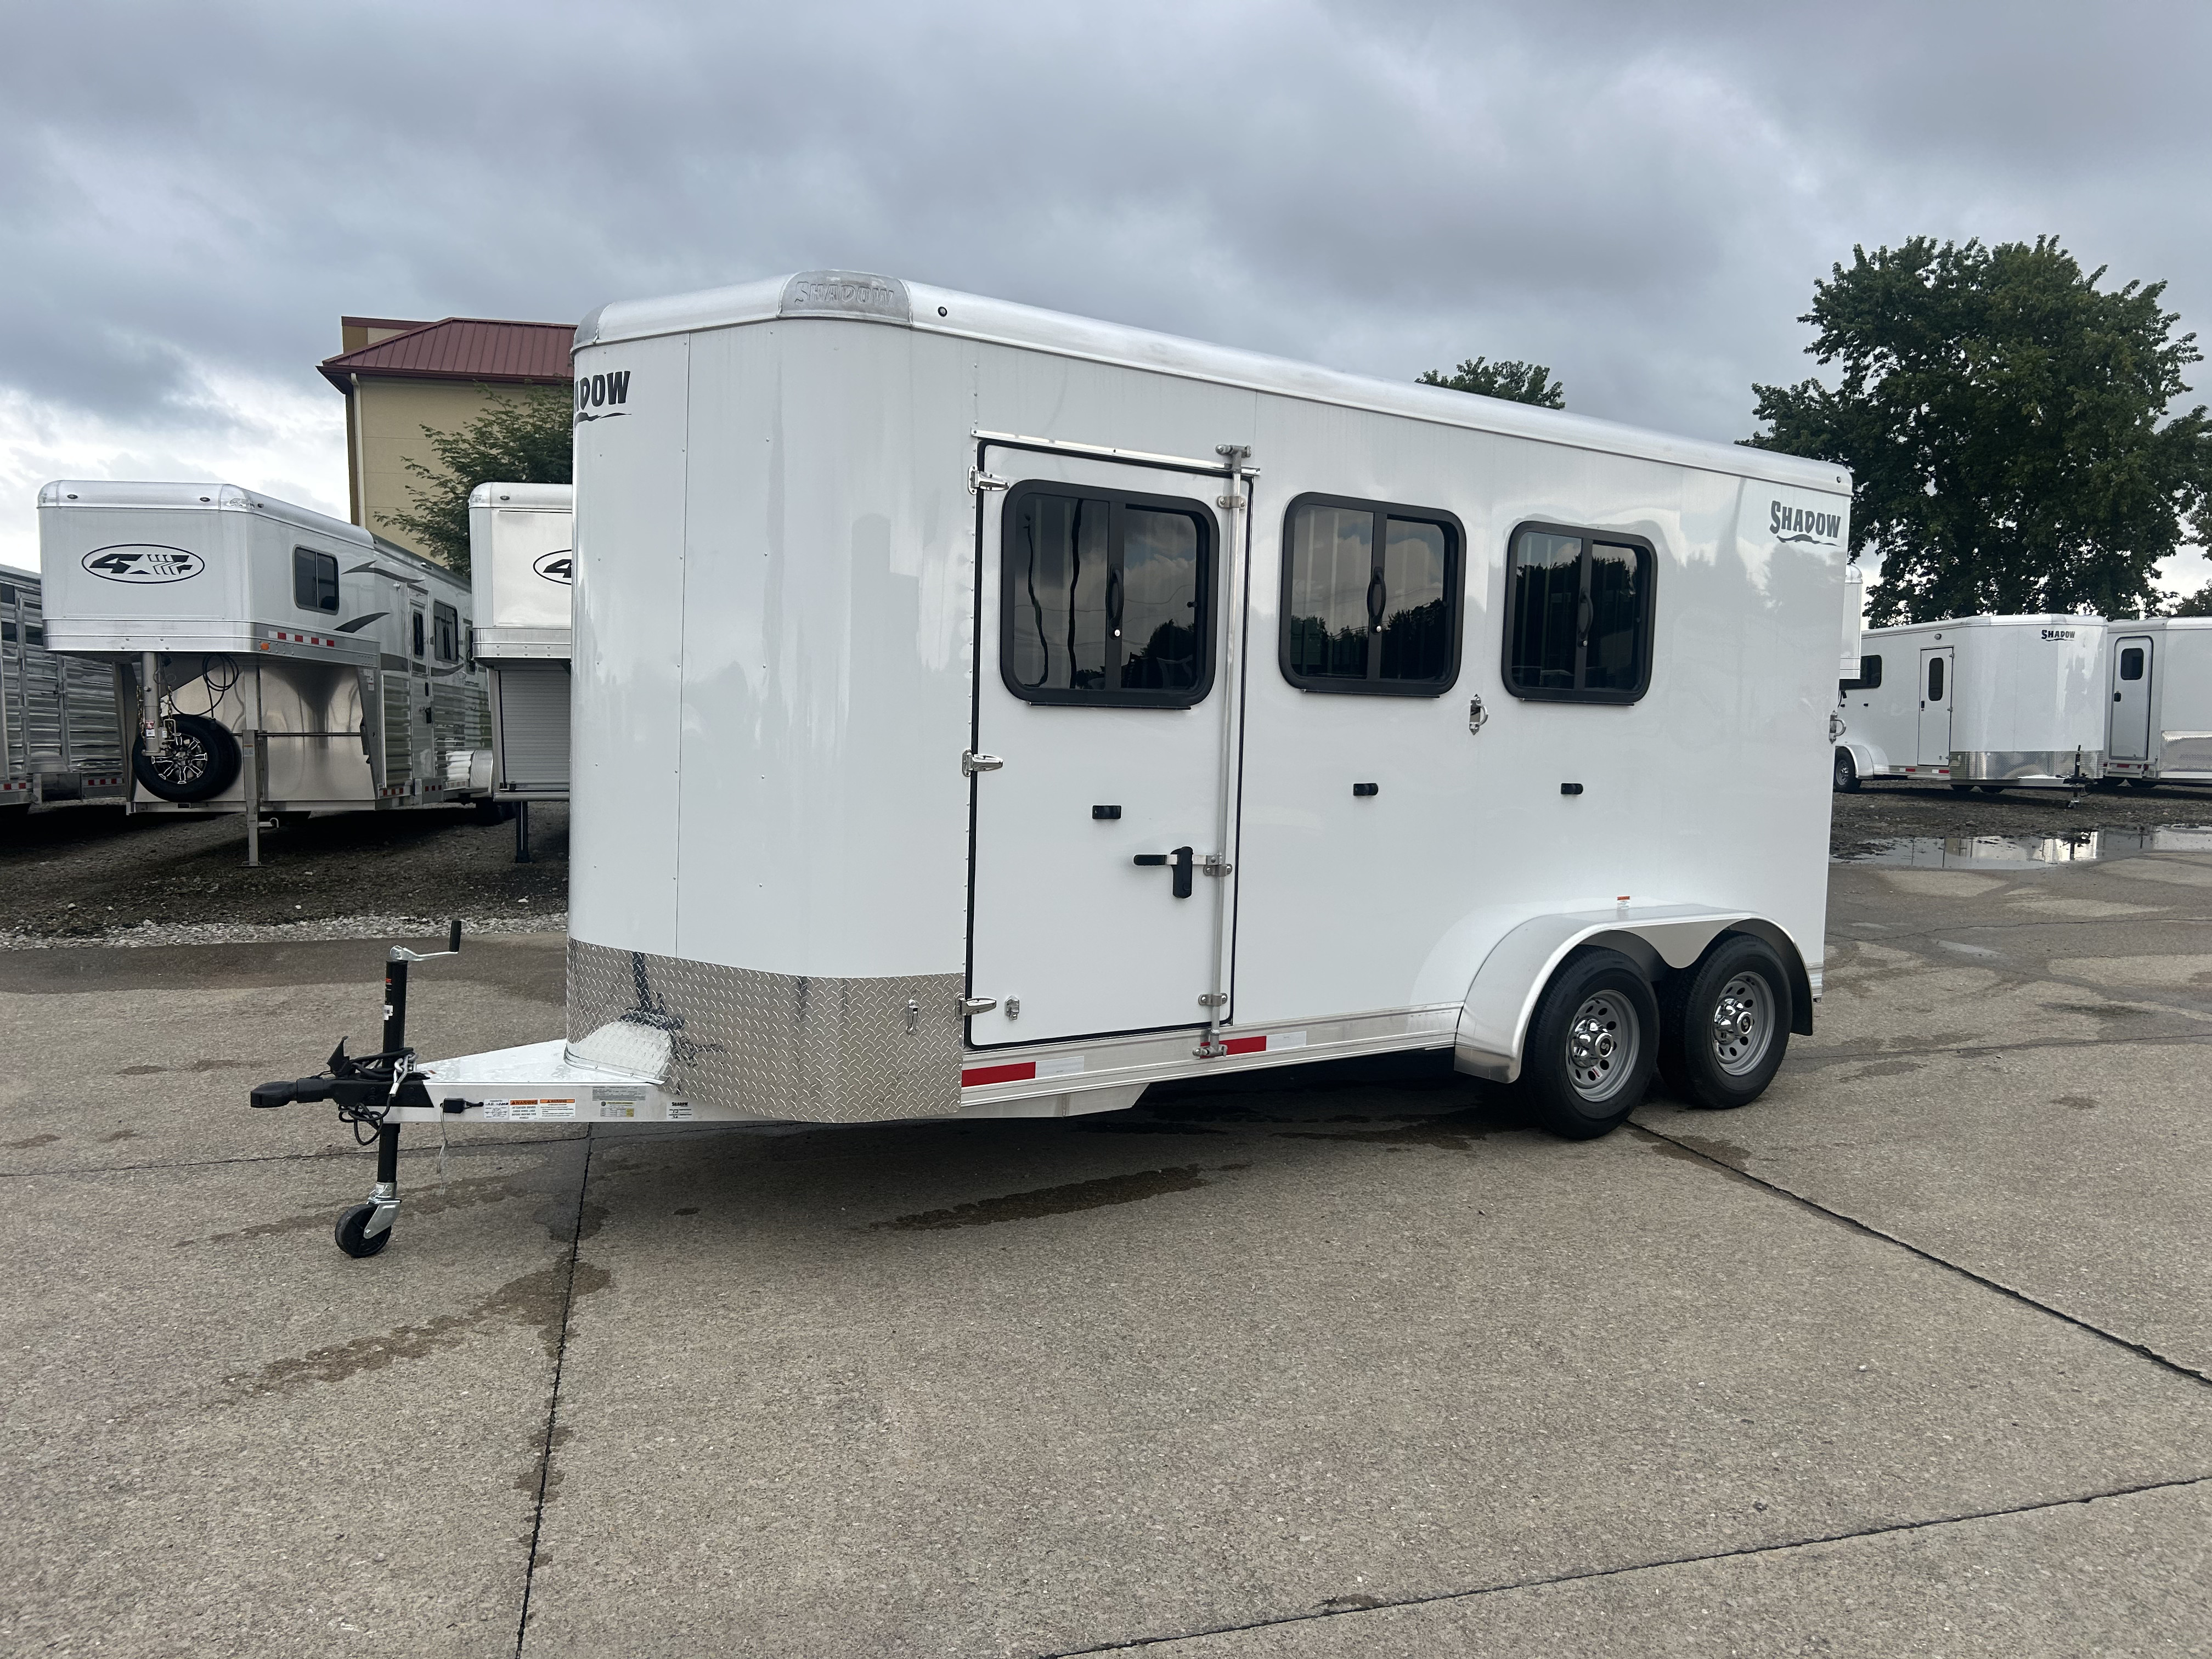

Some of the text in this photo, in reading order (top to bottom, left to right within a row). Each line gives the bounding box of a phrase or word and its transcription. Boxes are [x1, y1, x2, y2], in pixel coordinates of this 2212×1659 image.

[794, 281, 894, 307] SHADOW
[574, 371, 630, 413] DOW
[1769, 500, 1841, 538] SHADOW
[2041, 629, 2075, 639] SHADOW
